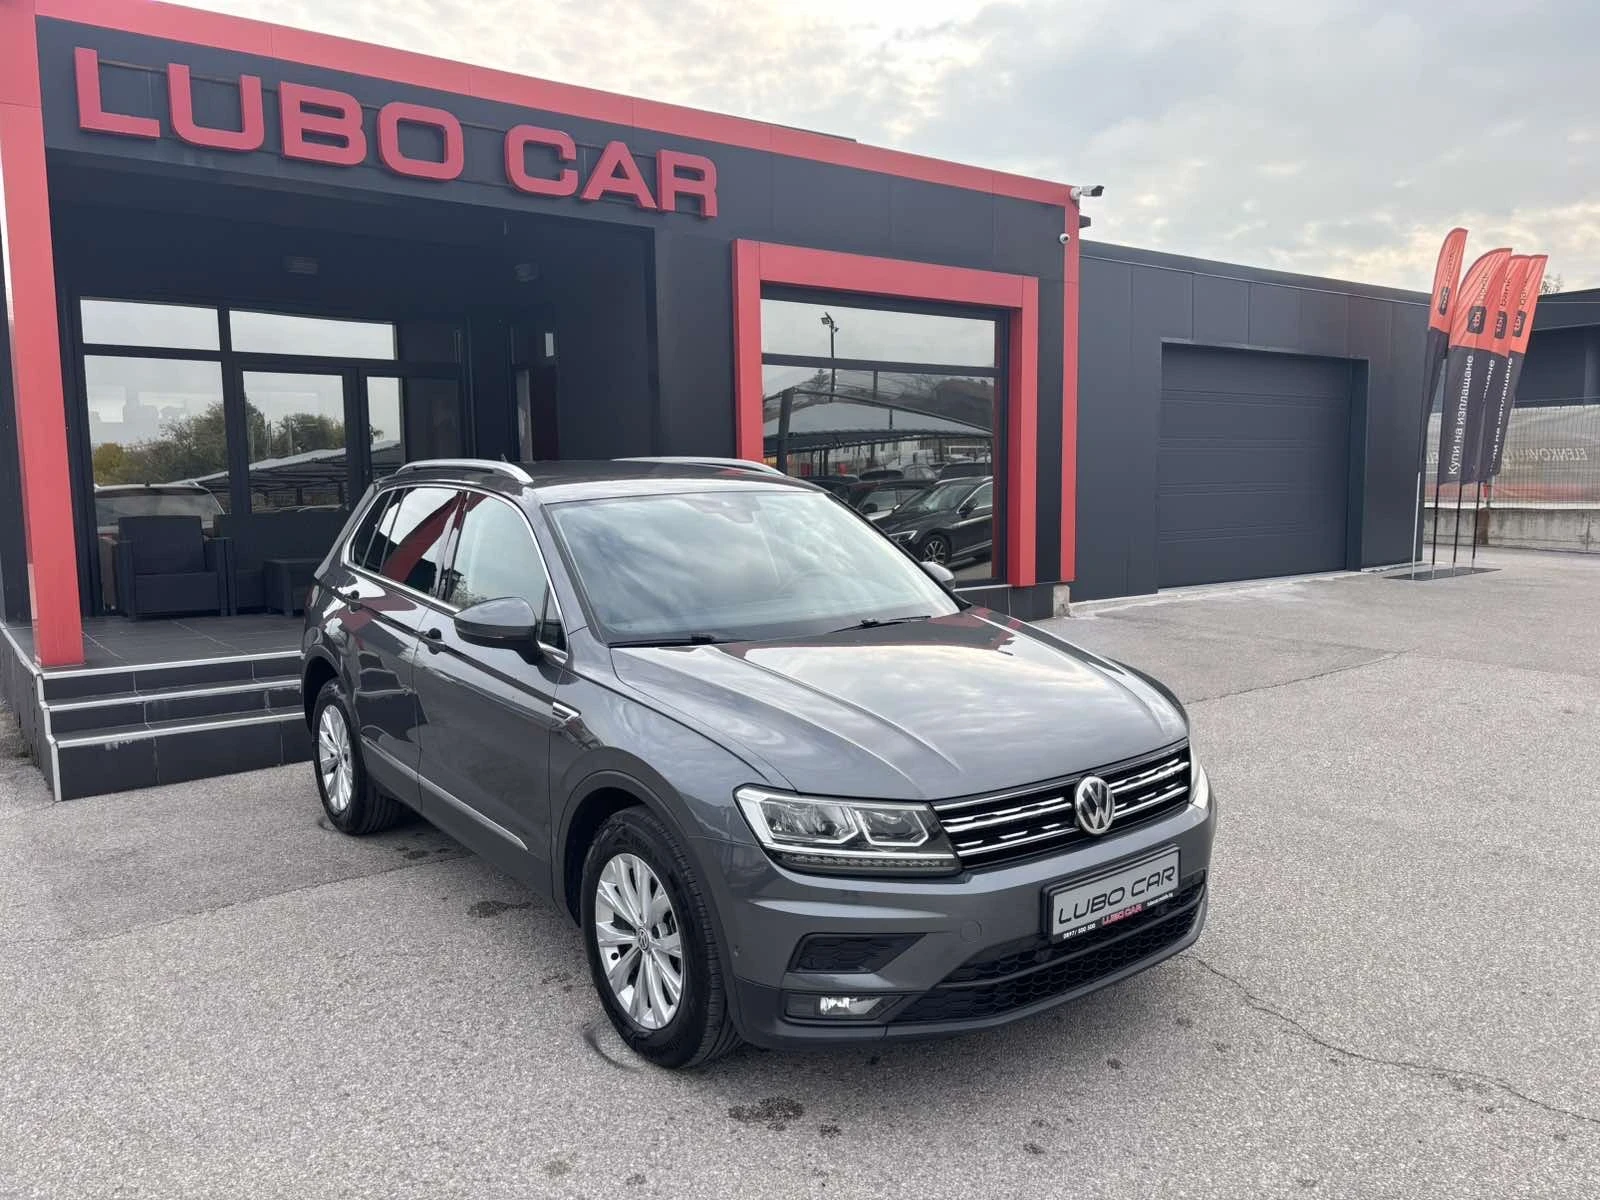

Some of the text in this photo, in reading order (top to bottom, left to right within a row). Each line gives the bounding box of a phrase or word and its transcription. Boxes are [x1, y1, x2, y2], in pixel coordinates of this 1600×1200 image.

[73, 46, 718, 218] LUBO CAR
[1448, 355, 1474, 474] Купи на изплащане
[1058, 886, 1125, 924] LUBO
[1131, 865, 1175, 897] CAR
[1101, 903, 1143, 926] LUBO CAR
